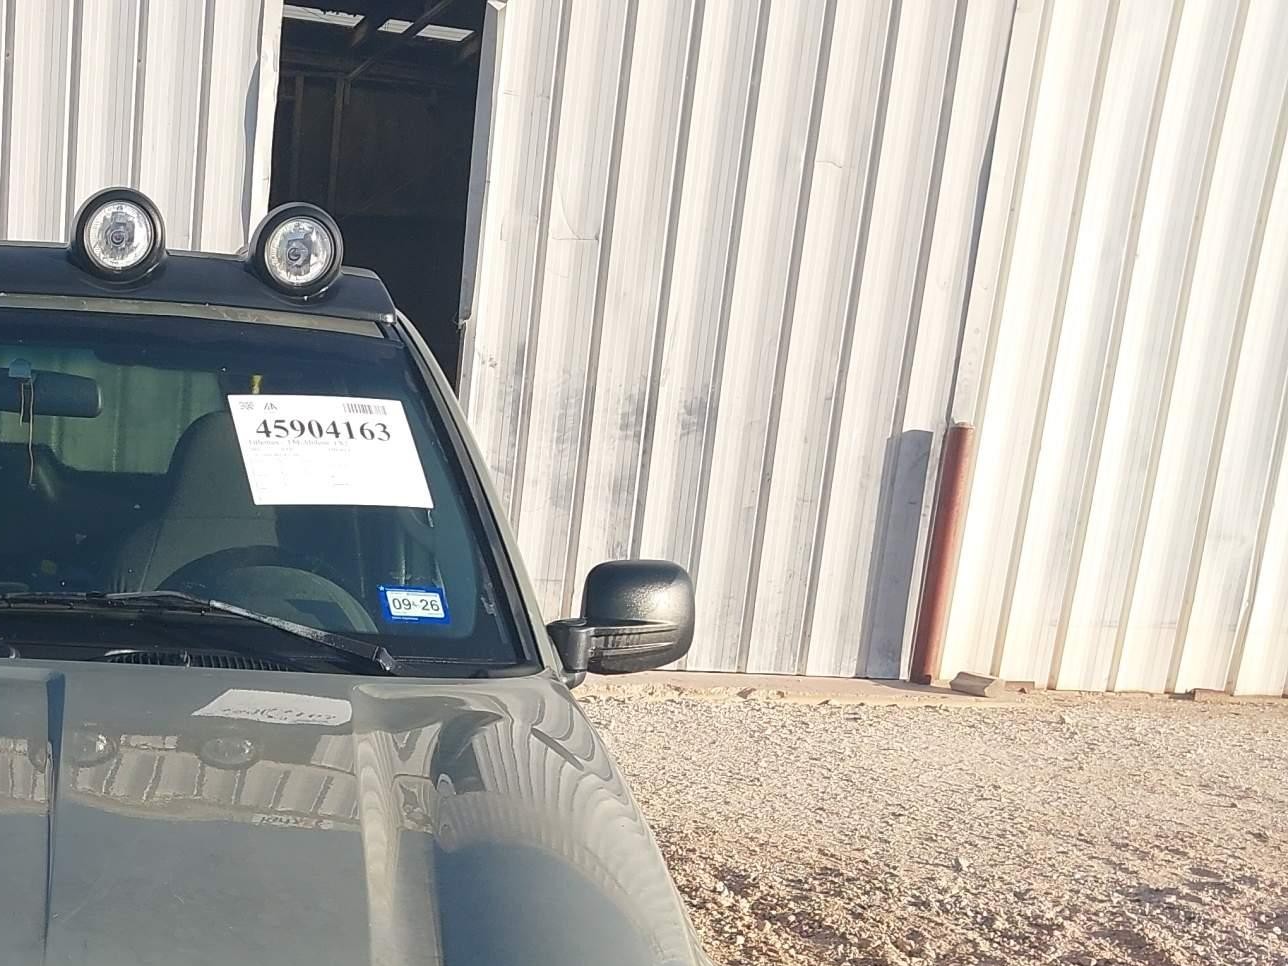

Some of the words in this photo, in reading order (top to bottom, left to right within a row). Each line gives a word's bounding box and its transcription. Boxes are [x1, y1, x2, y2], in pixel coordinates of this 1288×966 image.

[255, 418, 391, 442] 45904163
[392, 597, 412, 611] 09
[419, 598, 440, 612] 26
